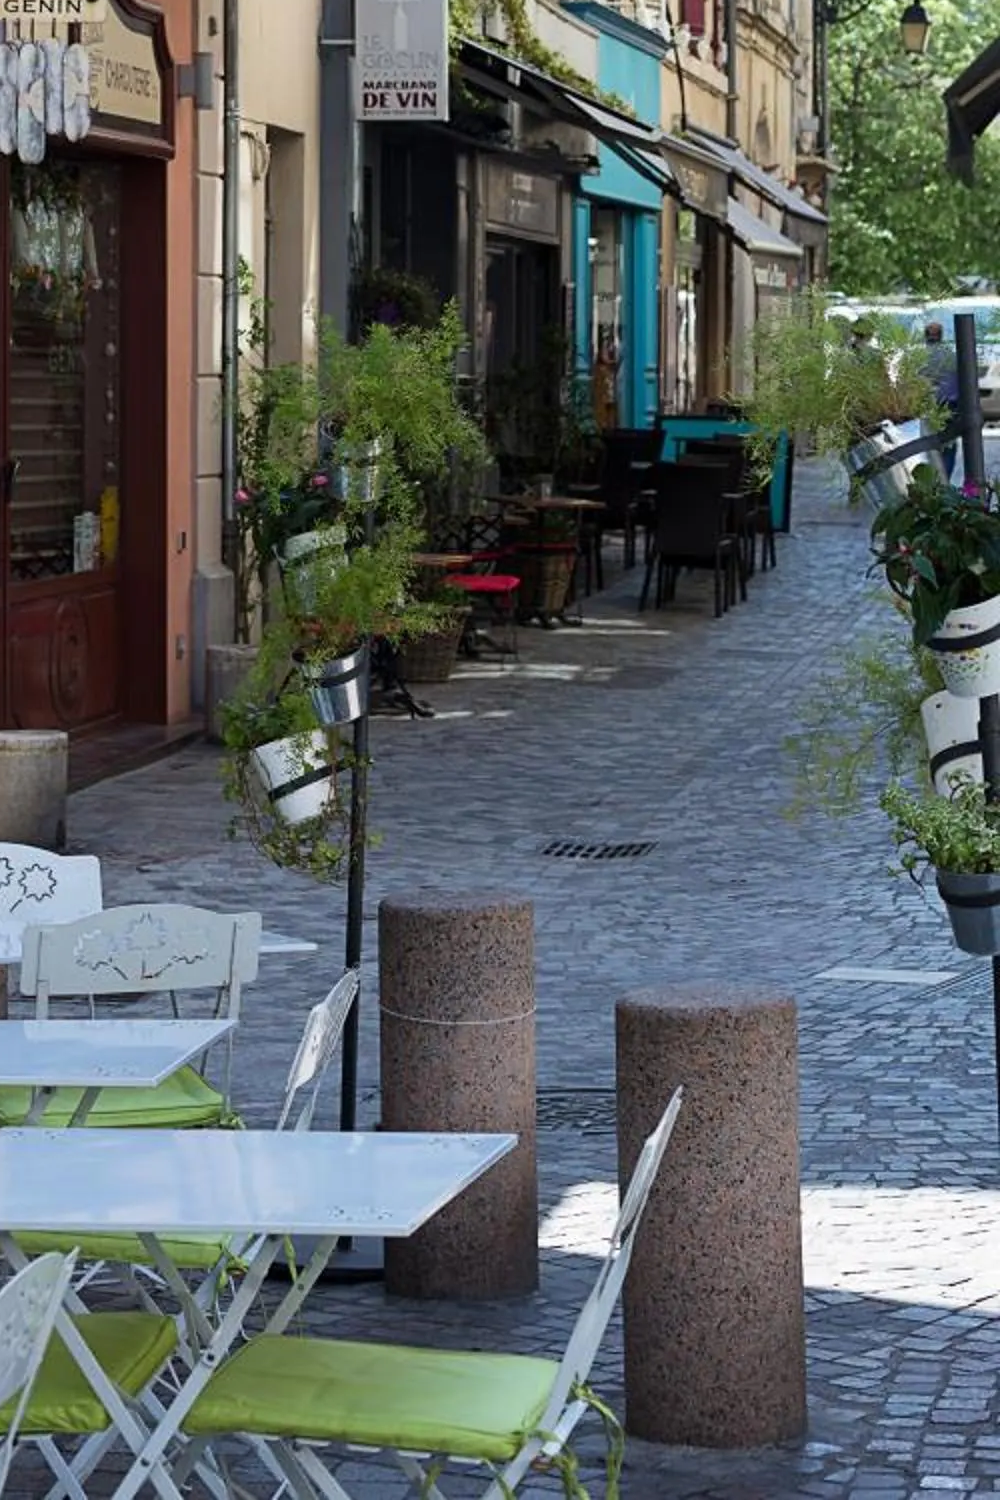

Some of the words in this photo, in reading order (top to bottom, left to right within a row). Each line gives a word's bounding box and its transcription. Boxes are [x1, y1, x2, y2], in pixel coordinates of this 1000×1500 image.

[362, 80, 438, 90] MARCHAND
[362, 91, 391, 109] DE
[396, 91, 438, 109] VIN
